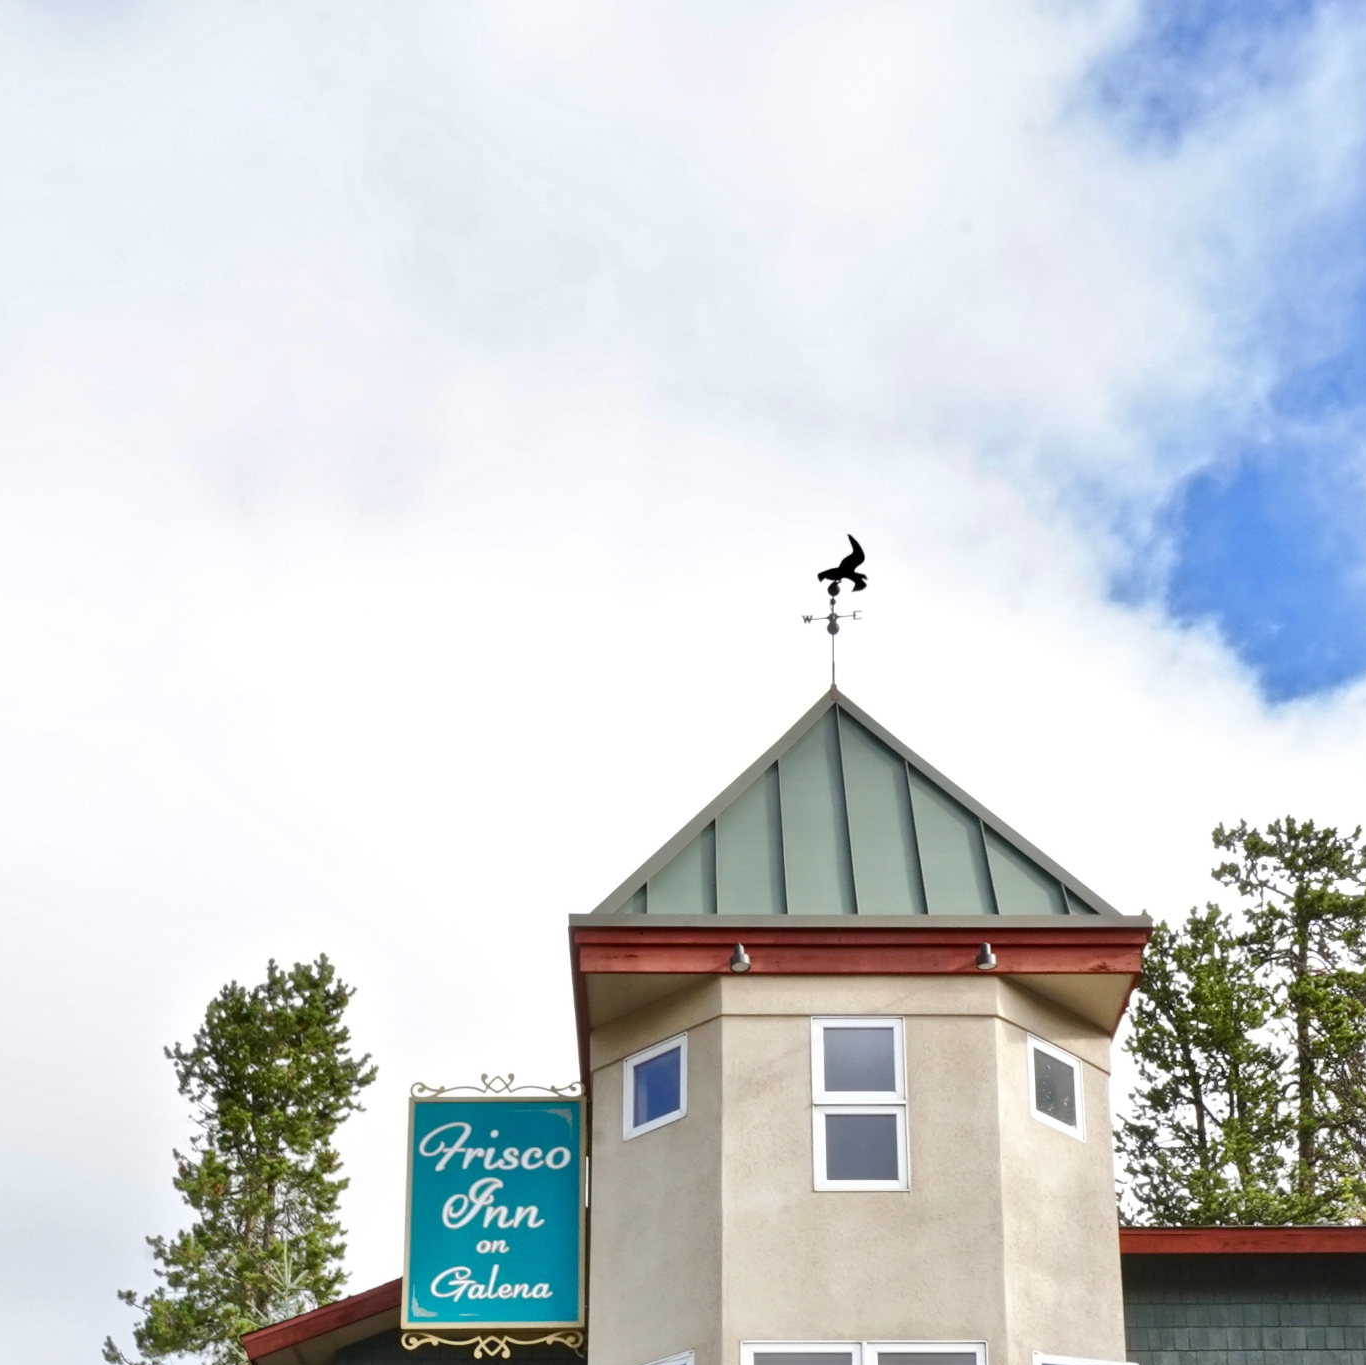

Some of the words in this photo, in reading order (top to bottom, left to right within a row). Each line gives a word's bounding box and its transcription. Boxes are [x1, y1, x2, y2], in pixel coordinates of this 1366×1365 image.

[419, 1121, 572, 1172] Frisco
[441, 1177, 545, 1229] Inn
[476, 1239, 510, 1254] on
[430, 1264, 553, 1302] Galena
